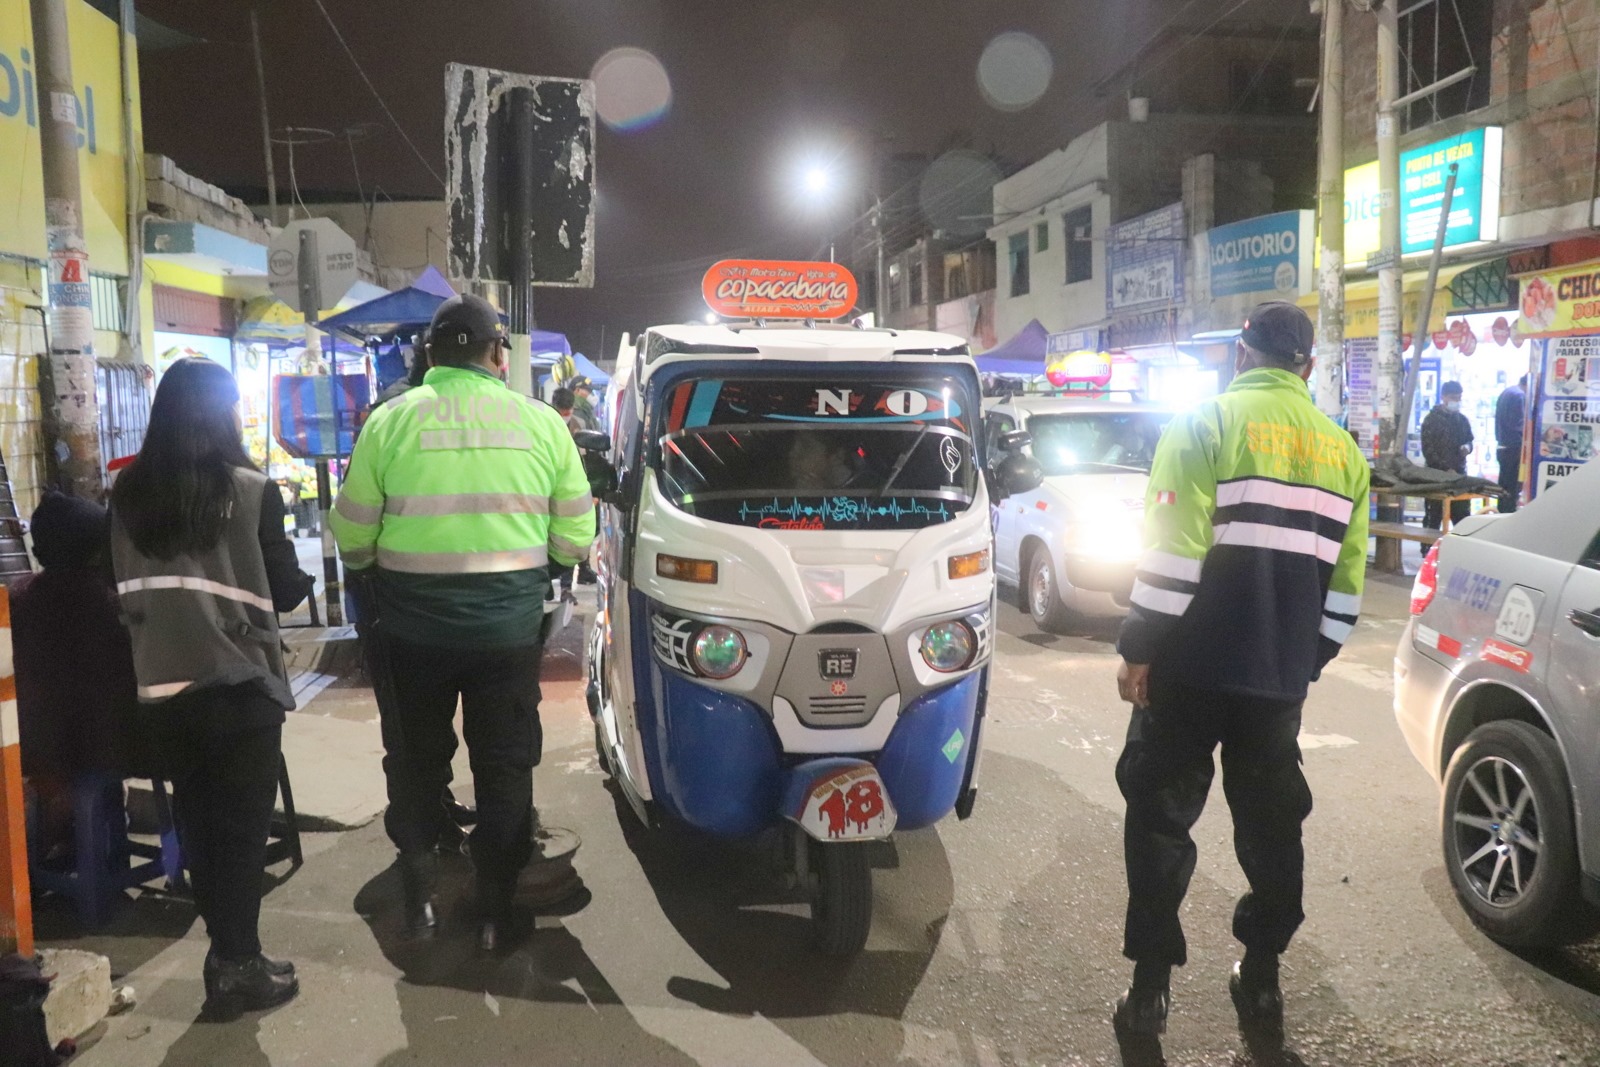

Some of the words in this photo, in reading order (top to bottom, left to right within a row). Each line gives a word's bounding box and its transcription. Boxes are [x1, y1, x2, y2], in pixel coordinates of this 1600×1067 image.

[1210, 230, 1297, 266] LOCUTORIO
[716, 274, 848, 305] copacabana
[1555, 348, 1581, 356] PARA
[417, 395, 523, 425] POLICIA
[1547, 464, 1579, 477] BAT
[826, 659, 853, 674] RE
[818, 780, 885, 839] 18
